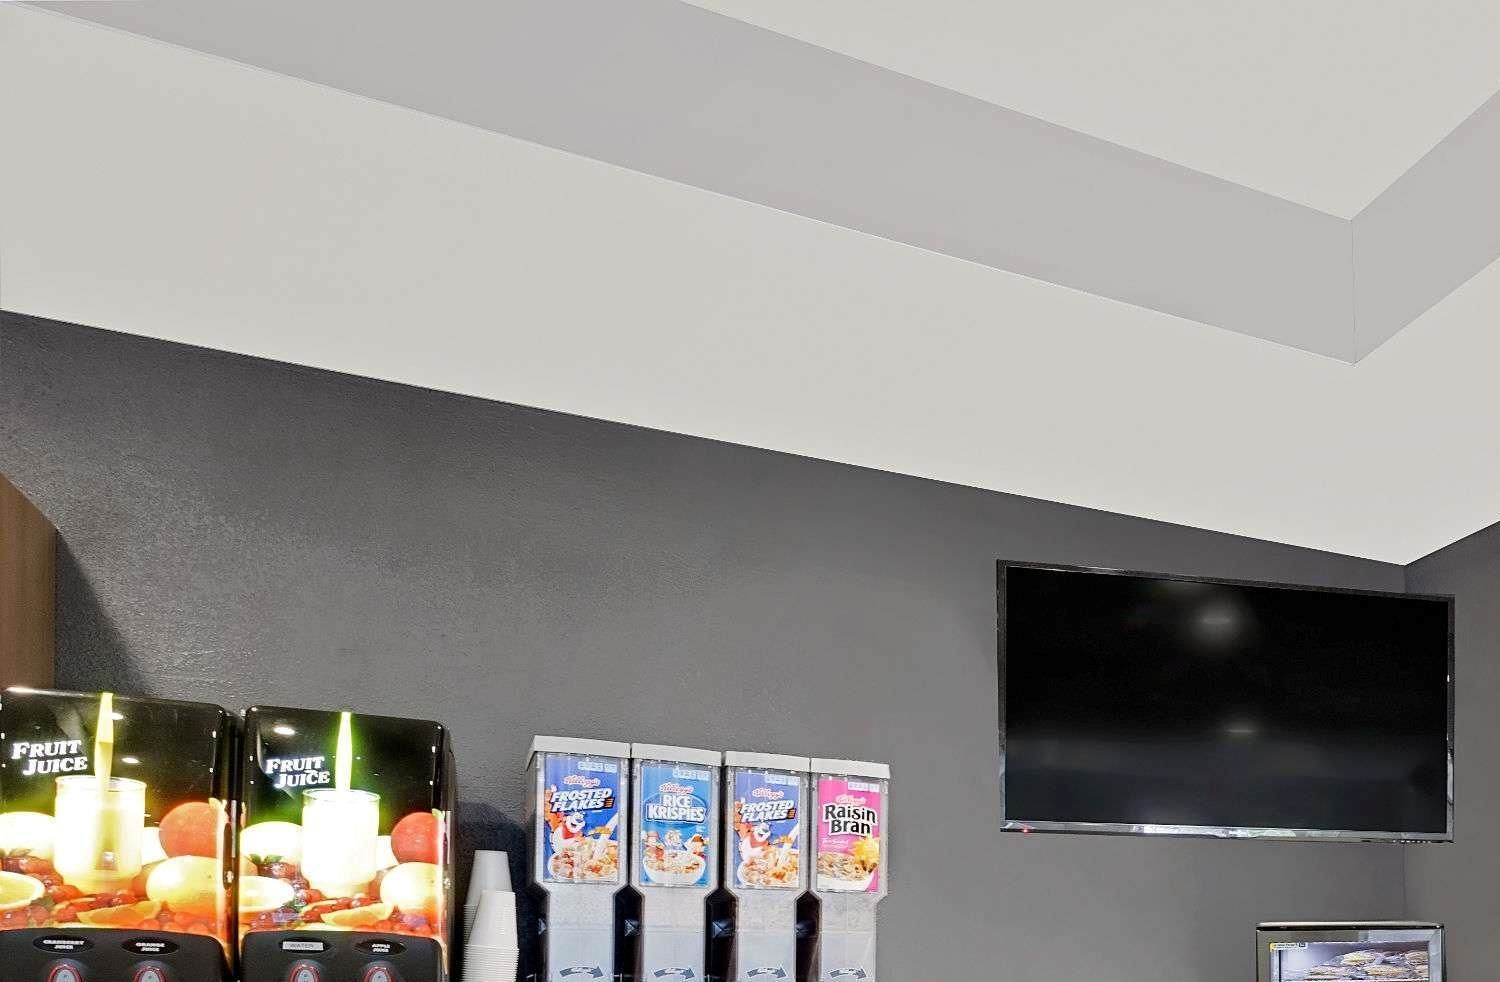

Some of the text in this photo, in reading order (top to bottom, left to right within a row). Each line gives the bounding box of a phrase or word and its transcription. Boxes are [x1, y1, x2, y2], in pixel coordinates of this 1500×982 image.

[11, 740, 82, 759] FRUIT
[22, 756, 88, 775] JUICE
[265, 756, 325, 774] FRUIT
[273, 769, 331, 788] JUICE
[550, 787, 613, 803] FROSTED
[662, 794, 691, 807] RICE
[551, 798, 605, 812] FLAKES
[647, 804, 705, 822] KRISPIES
[741, 800, 795, 815] FROSTED
[741, 810, 788, 823] FLAKES
[824, 804, 876, 824] Raisin
[830, 819, 871, 835] Bran
